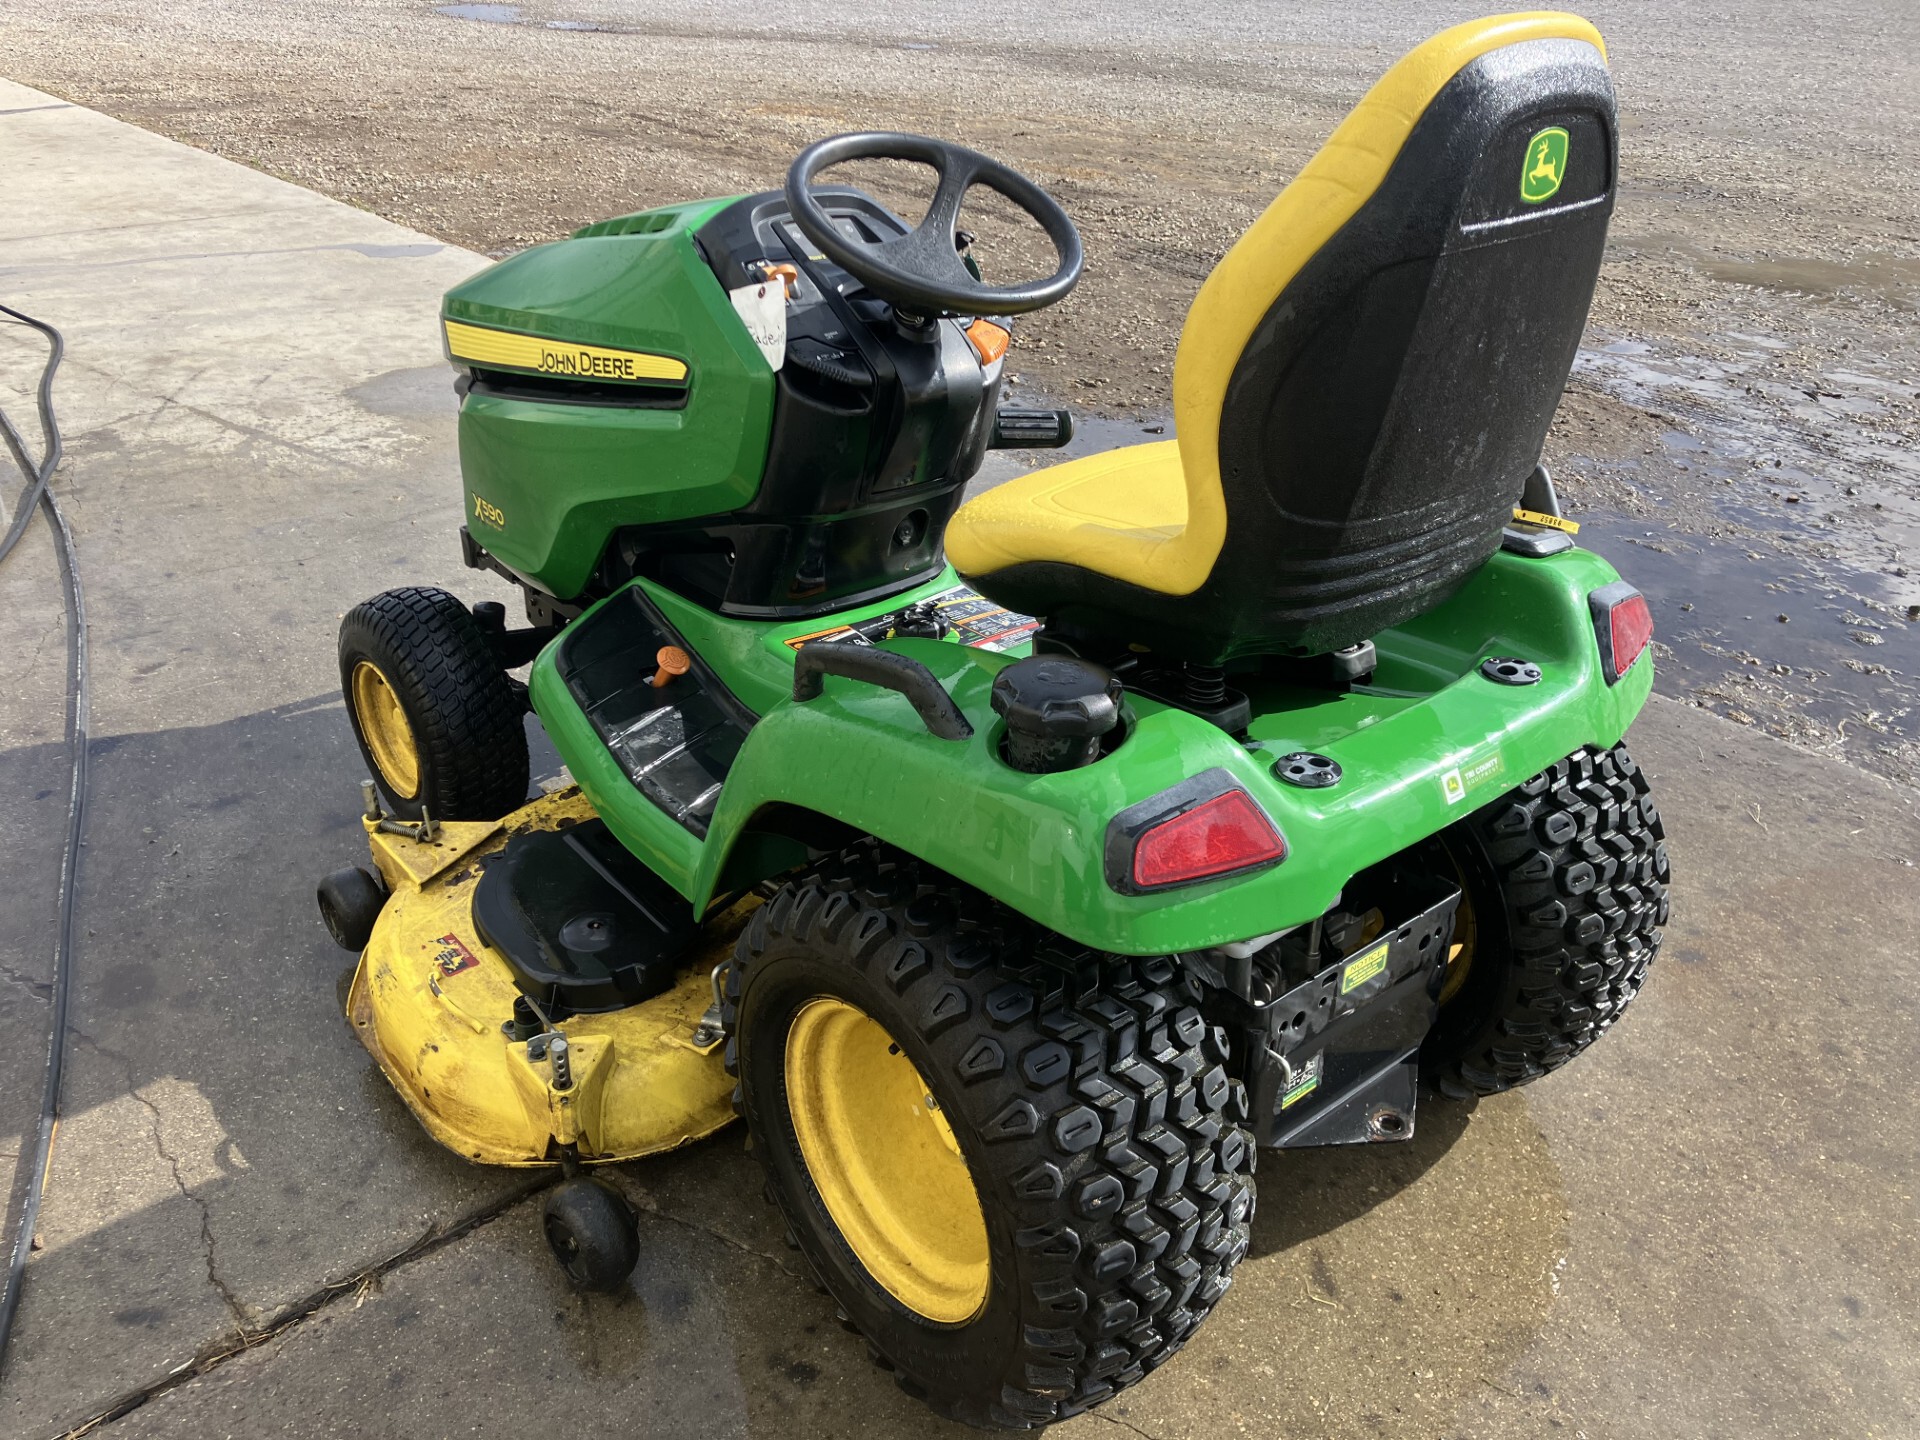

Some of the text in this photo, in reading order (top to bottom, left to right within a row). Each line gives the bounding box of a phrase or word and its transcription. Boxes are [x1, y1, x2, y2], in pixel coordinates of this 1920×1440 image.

[538, 349, 635, 377] JOHN DEERE
[472, 492, 505, 526] X590
[1464, 757, 1498, 780] TRI COUNTY
[1350, 951, 1382, 972] NOTICE
